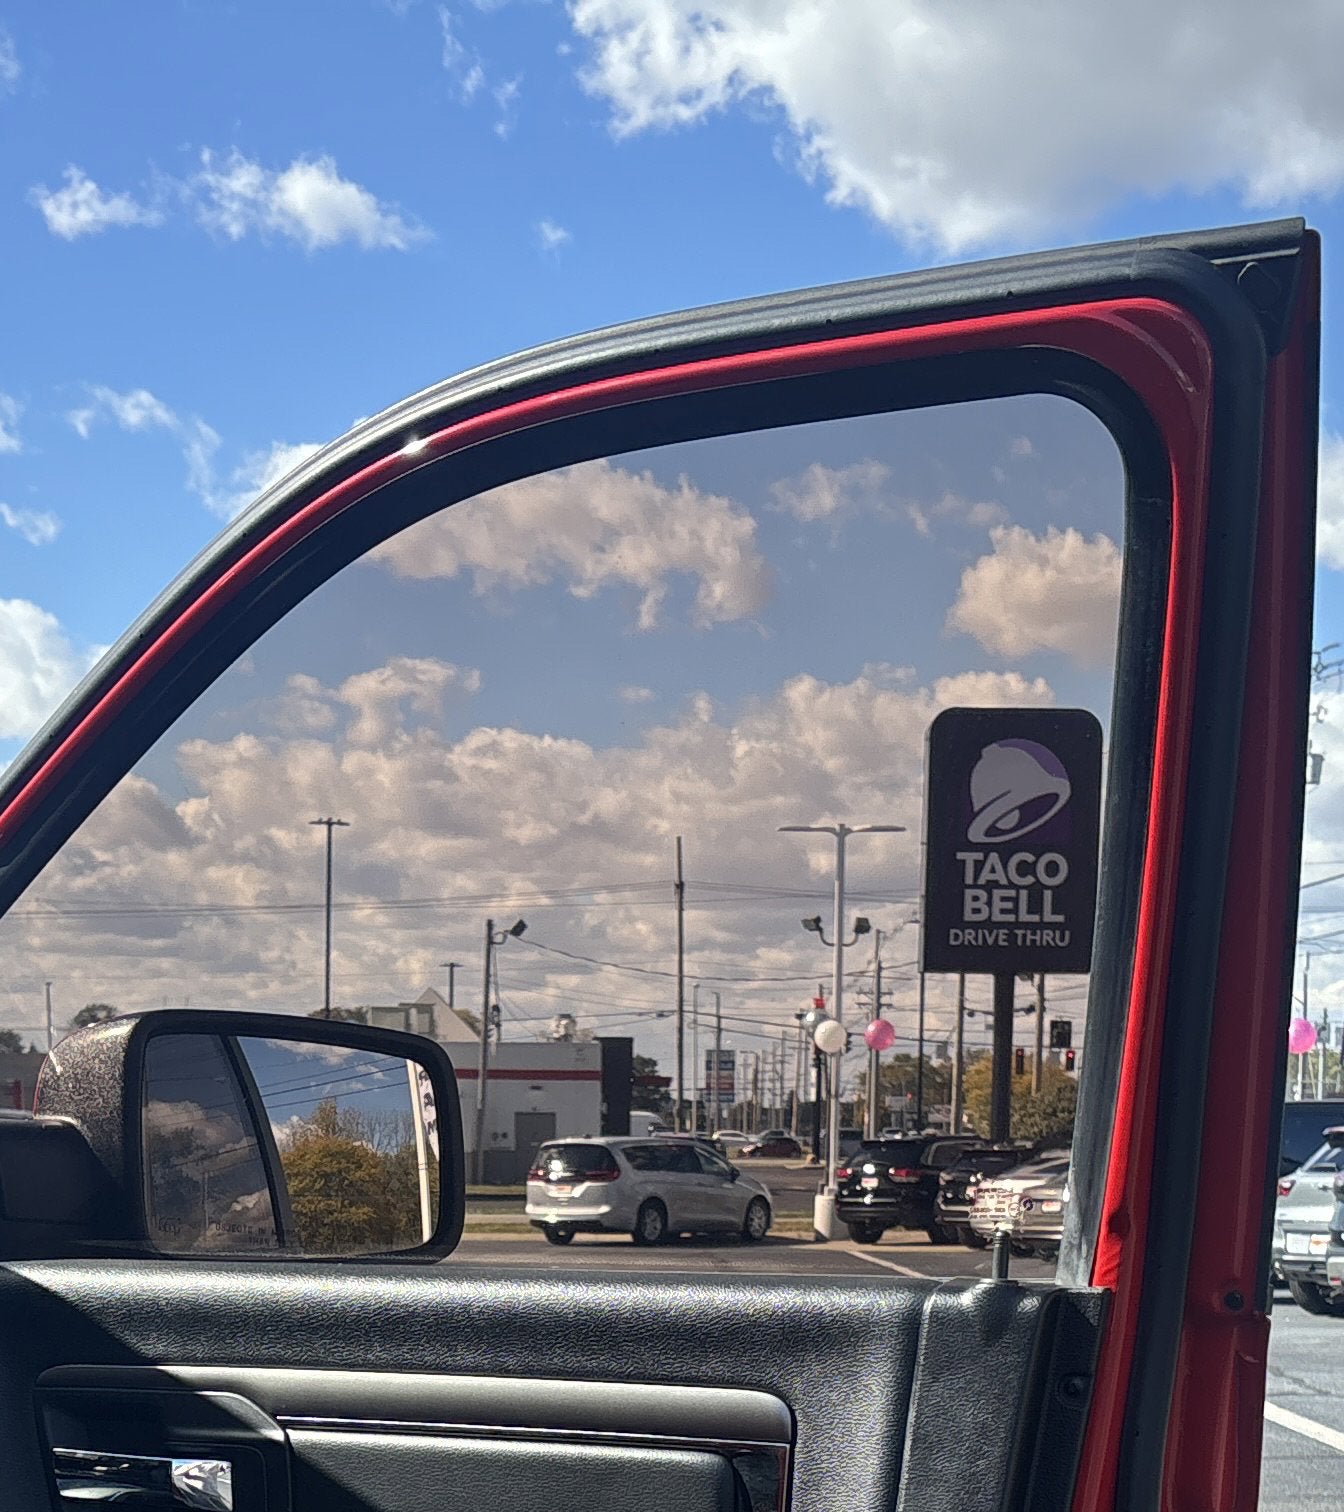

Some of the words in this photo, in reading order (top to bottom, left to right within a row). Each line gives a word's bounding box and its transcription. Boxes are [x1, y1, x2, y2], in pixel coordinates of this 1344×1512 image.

[956, 851, 1069, 887] TACO
[963, 888, 1065, 923] BELL
[948, 928, 1009, 947] DRIVE
[1013, 929, 1071, 947] THRU
